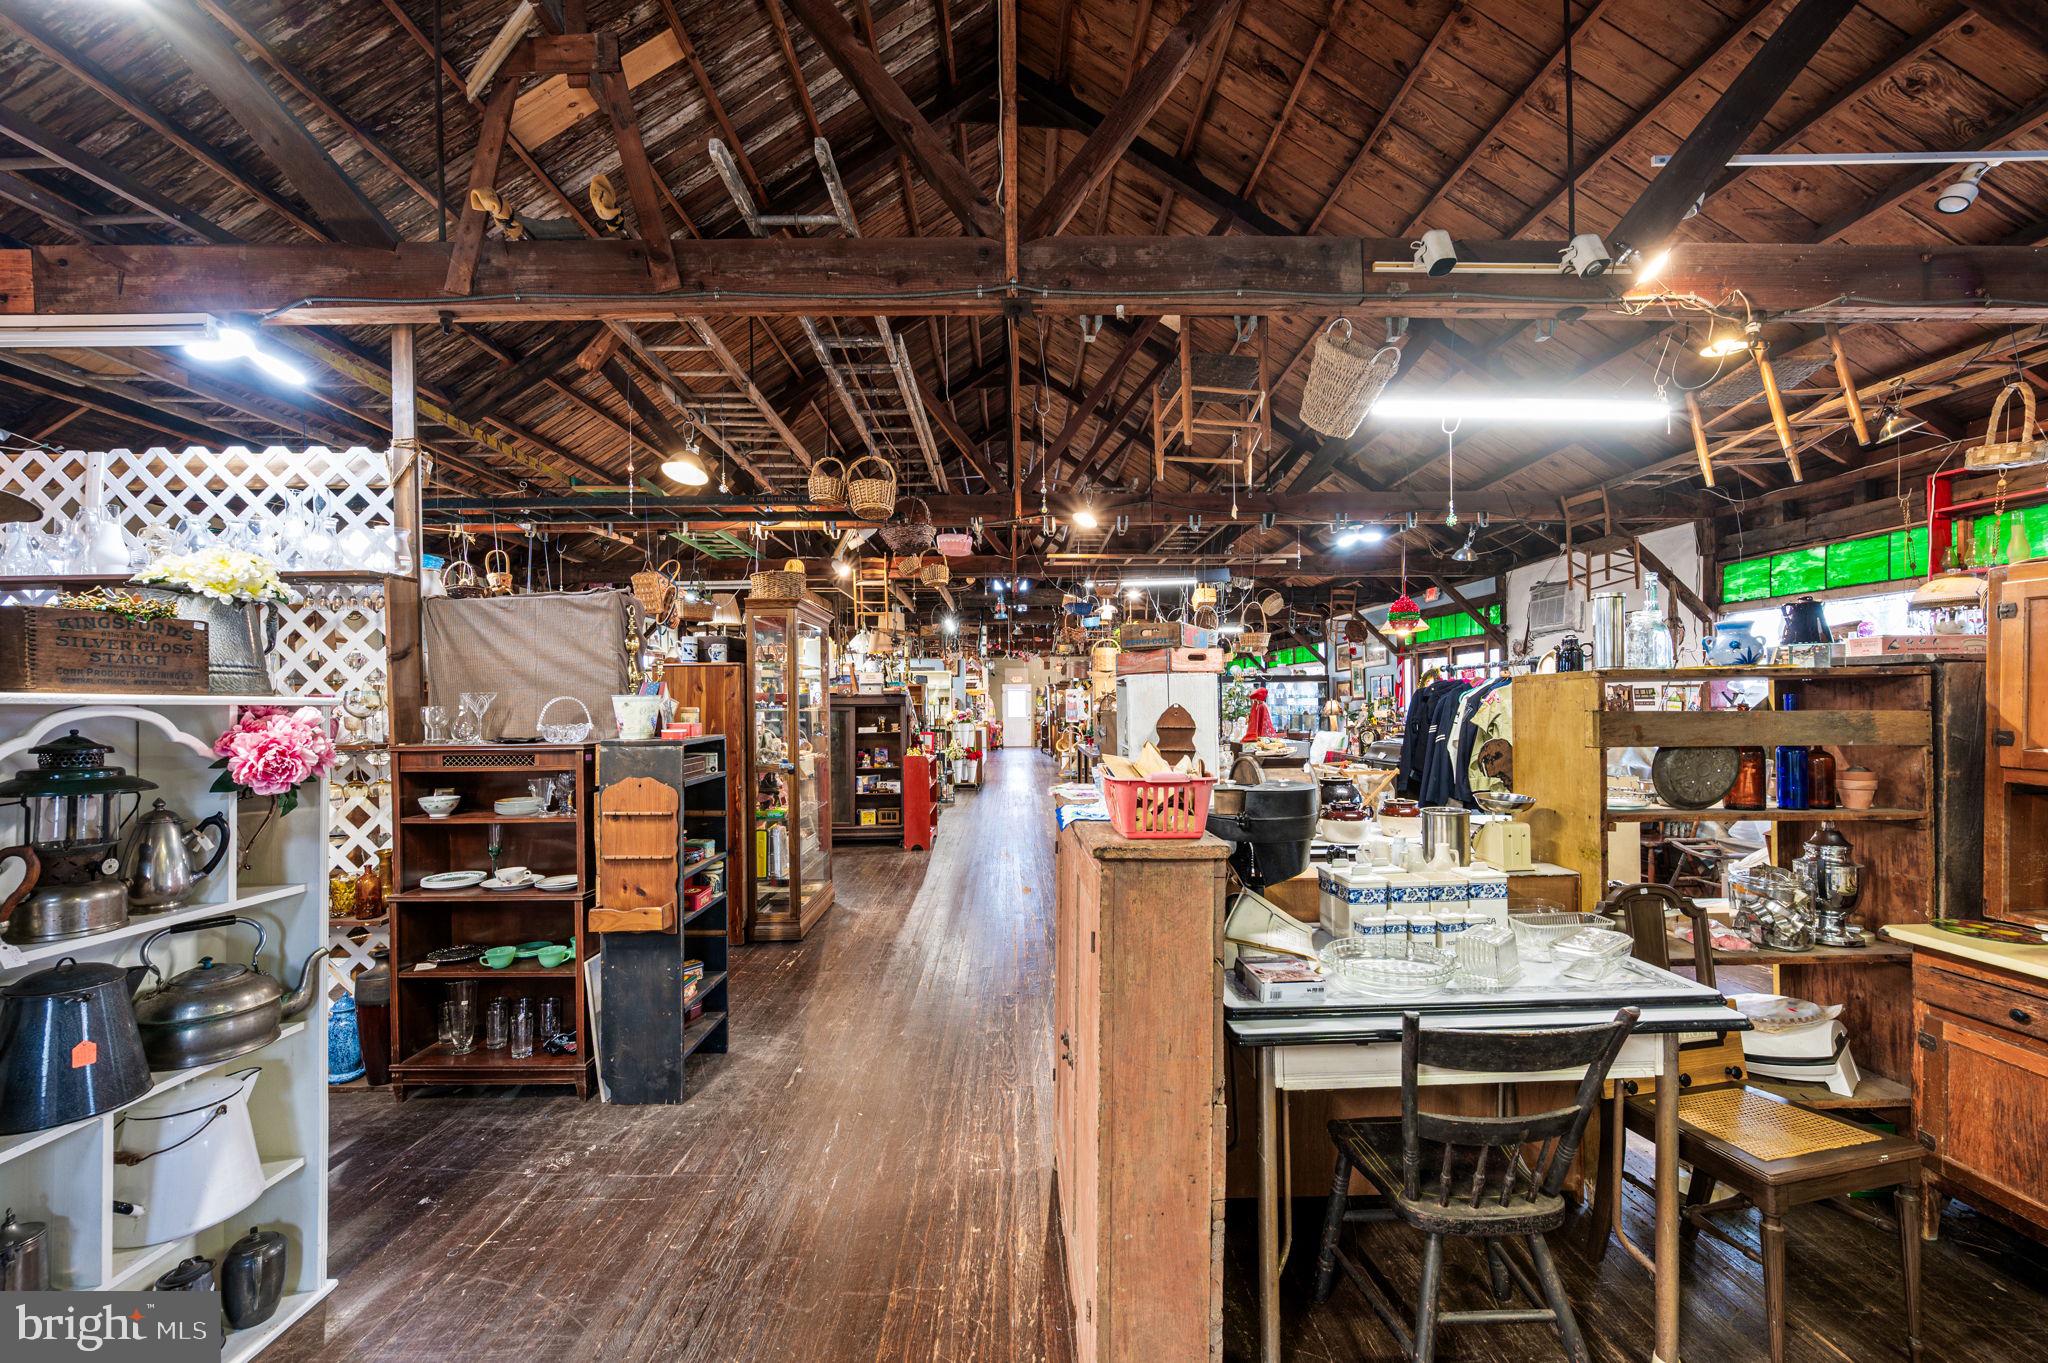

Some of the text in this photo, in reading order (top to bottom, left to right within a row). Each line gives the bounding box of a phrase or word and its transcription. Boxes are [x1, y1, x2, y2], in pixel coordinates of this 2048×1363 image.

[56, 617, 194, 641] KINGSFORD'S
[55, 635, 194, 654] SILVER GLOSS
[89, 652, 168, 666] STARCH
[86, 667, 137, 678] PRODUCTS
